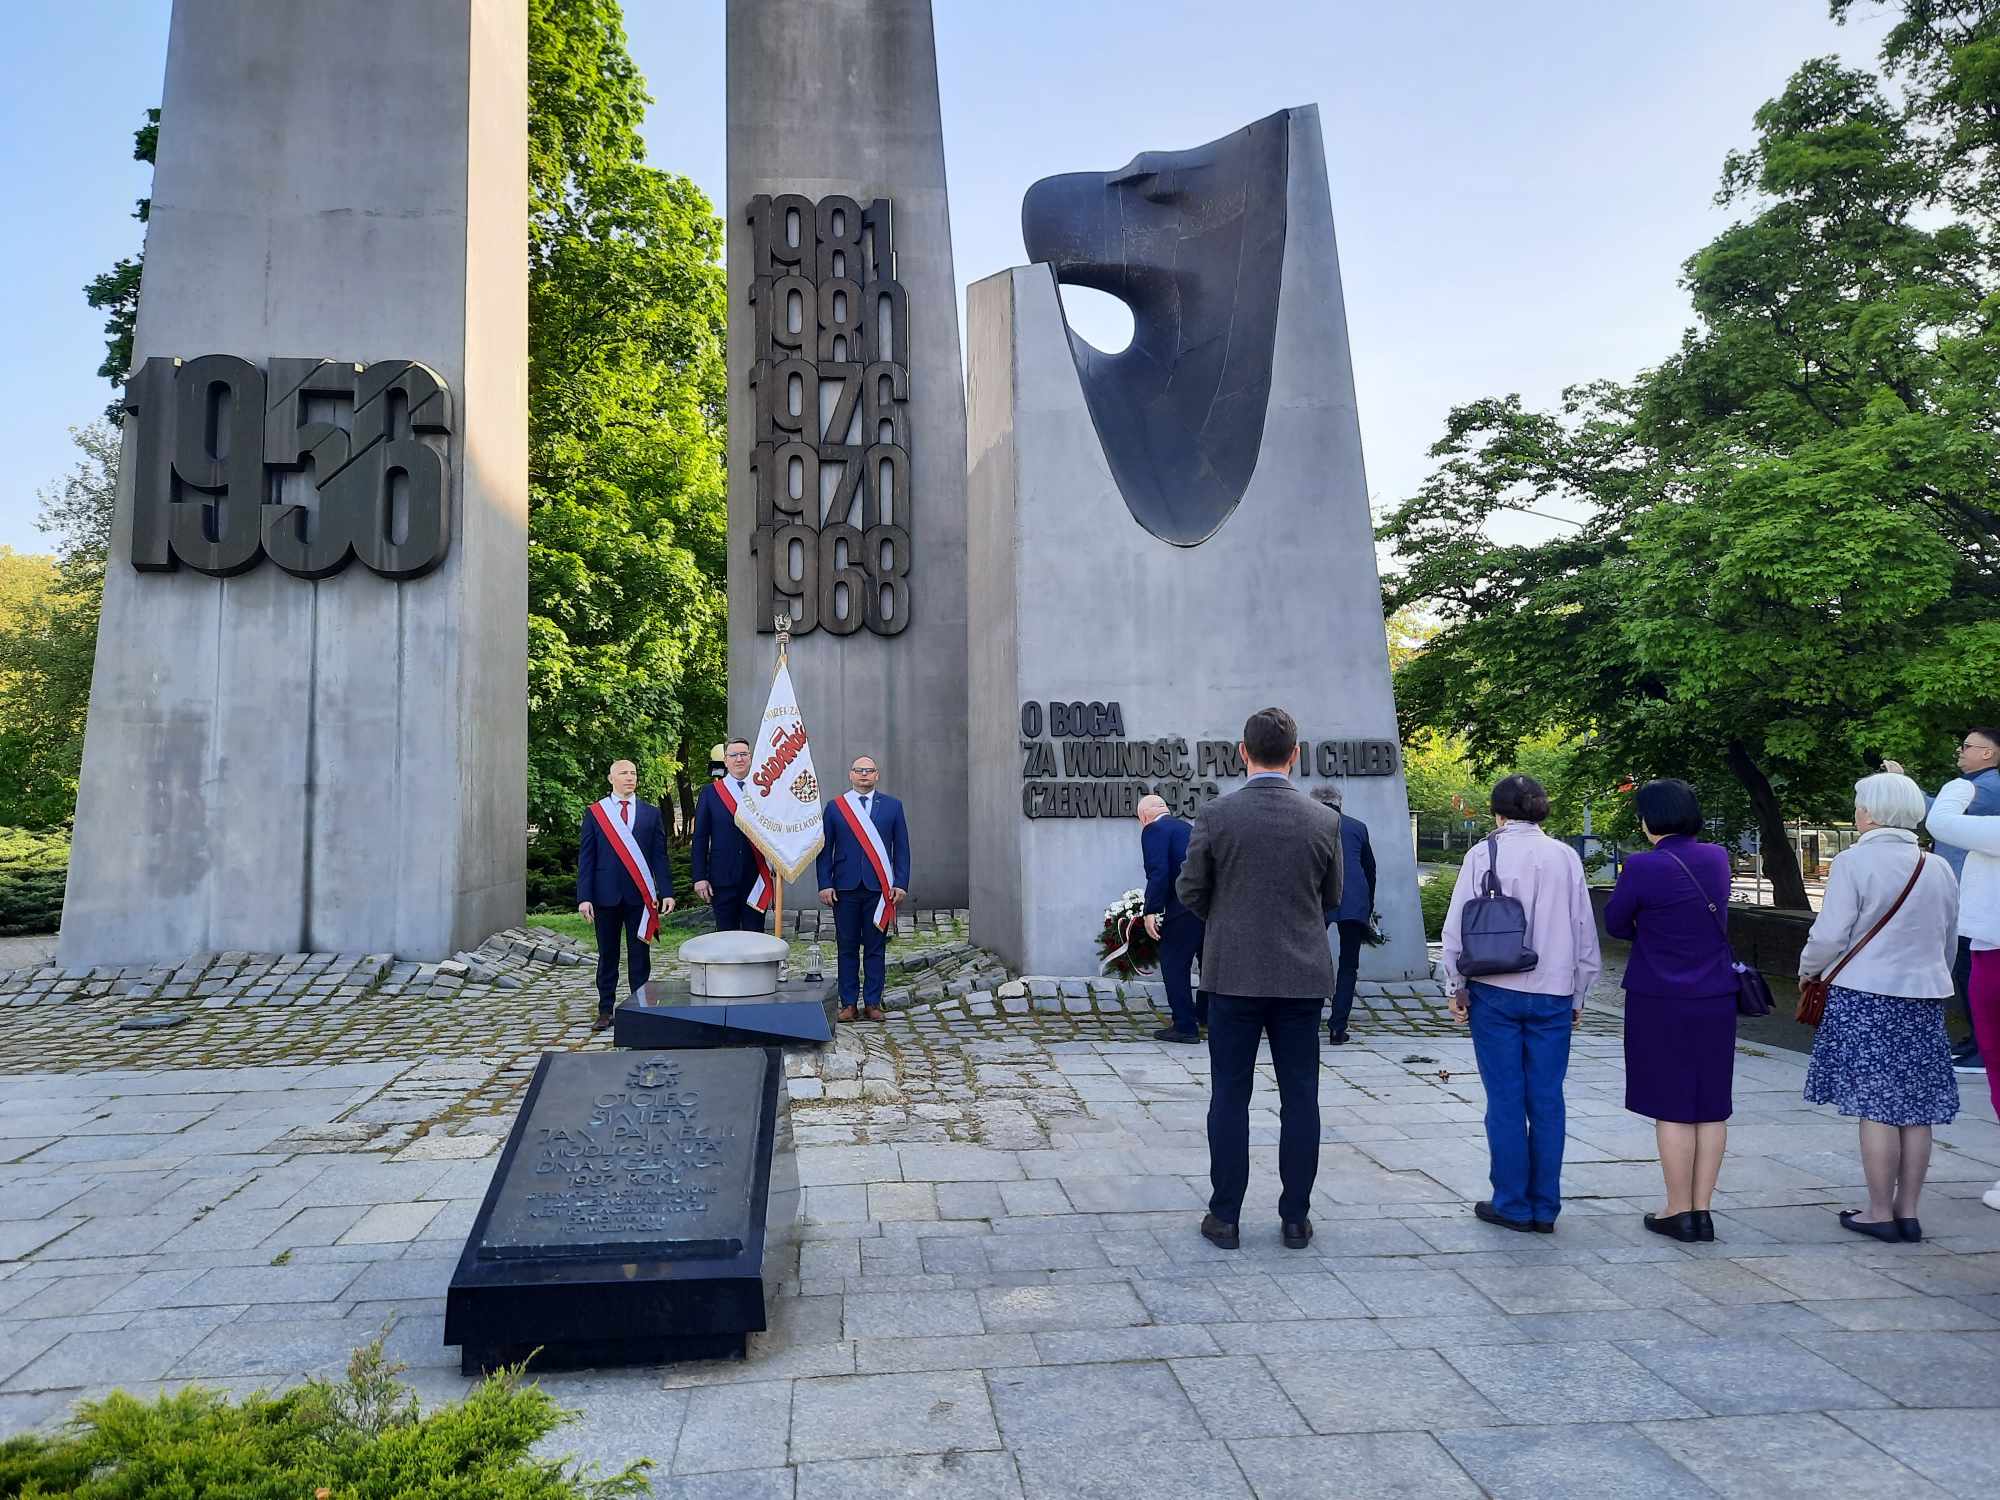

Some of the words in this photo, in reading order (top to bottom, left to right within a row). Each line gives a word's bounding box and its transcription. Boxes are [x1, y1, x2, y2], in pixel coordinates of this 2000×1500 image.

[746, 194, 897, 281] 1981
[748, 275, 910, 364] 1980
[749, 359, 910, 447] 1976
[125, 354, 452, 579] 1956
[750, 441, 911, 527] 1970
[750, 524, 911, 635] 1968
[1021, 701, 1042, 737] O
[1050, 701, 1125, 737] BOGA
[1022, 741, 1057, 777] ZA
[1316, 740, 1397, 777] CHLEB
[1022, 781, 1150, 819] CZERWIEC
[593, 1092, 699, 1108] OJCIEC
[537, 1127, 595, 1144] JAN
[536, 1160, 593, 1174] DNIA
